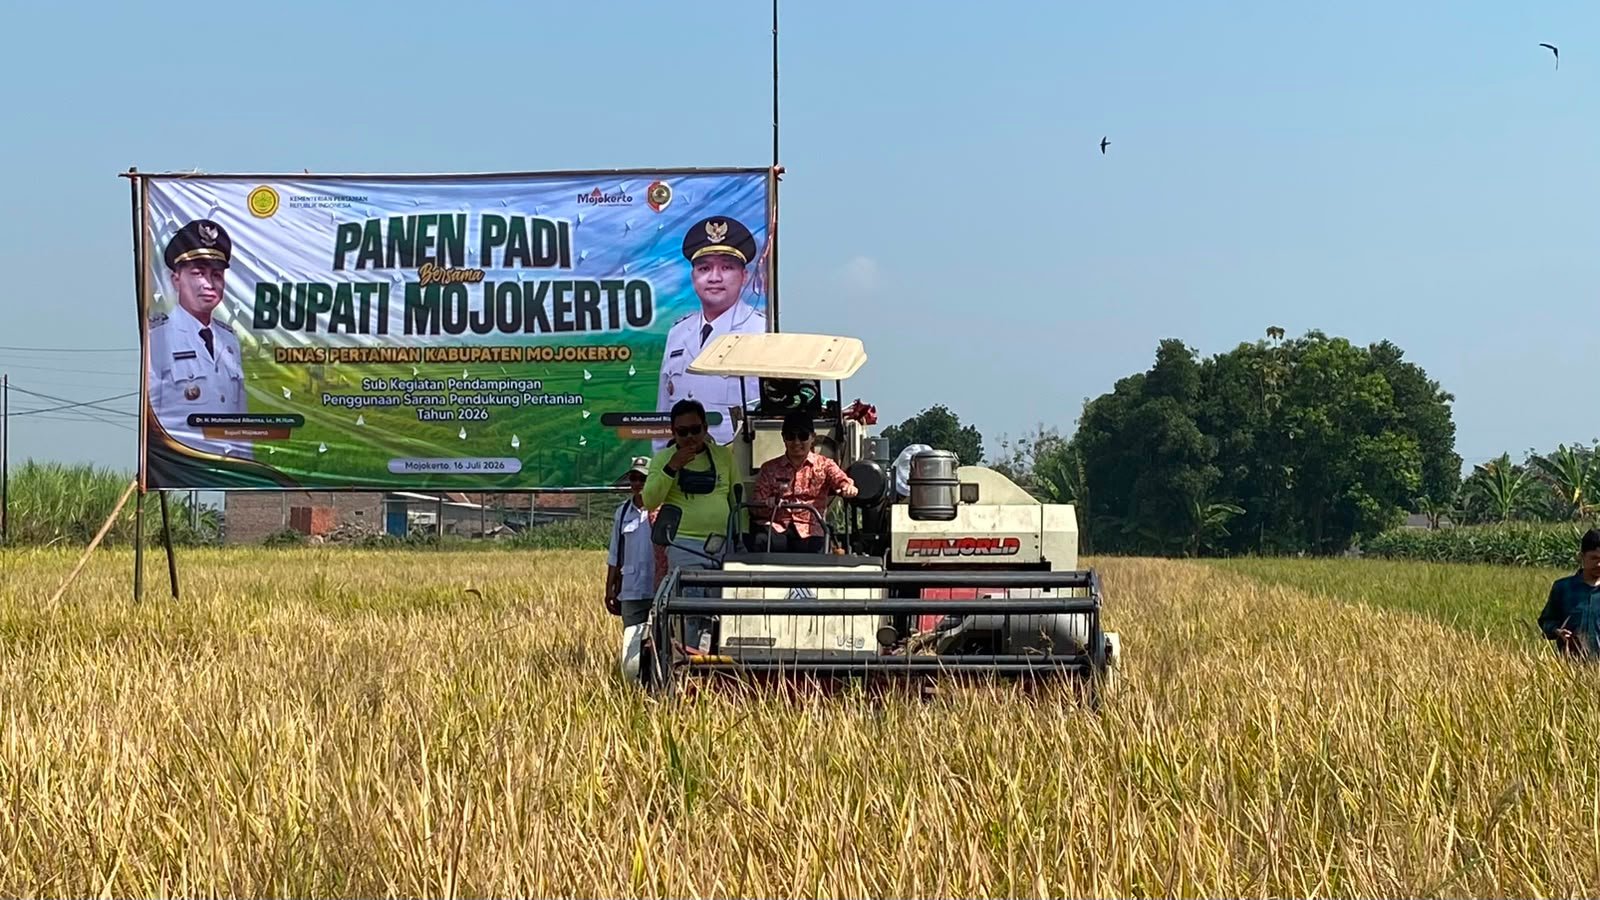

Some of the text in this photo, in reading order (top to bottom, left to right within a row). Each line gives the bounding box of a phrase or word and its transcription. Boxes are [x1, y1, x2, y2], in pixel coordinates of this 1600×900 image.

[577, 193, 633, 206] Mojokerto
[333, 213, 571, 271] PANEN PADI
[418, 262, 485, 287] Bersama
[253, 279, 652, 336] BUPATI MOJOKERTO
[275, 346, 631, 363] DINAS PERTANIAN KABUPATEN MOJOKERTO
[362, 378, 542, 393] Sub Kegiatan Pendampingan
[323, 393, 583, 408] Penggunaan Sarana Pendukung Pertanian
[416, 408, 489, 420] Tahun 2026
[453, 461, 464, 470] 16
[465, 461, 482, 470] Juli
[483, 461, 505, 470] 2026
[905, 537, 1020, 557] FMWORLD
